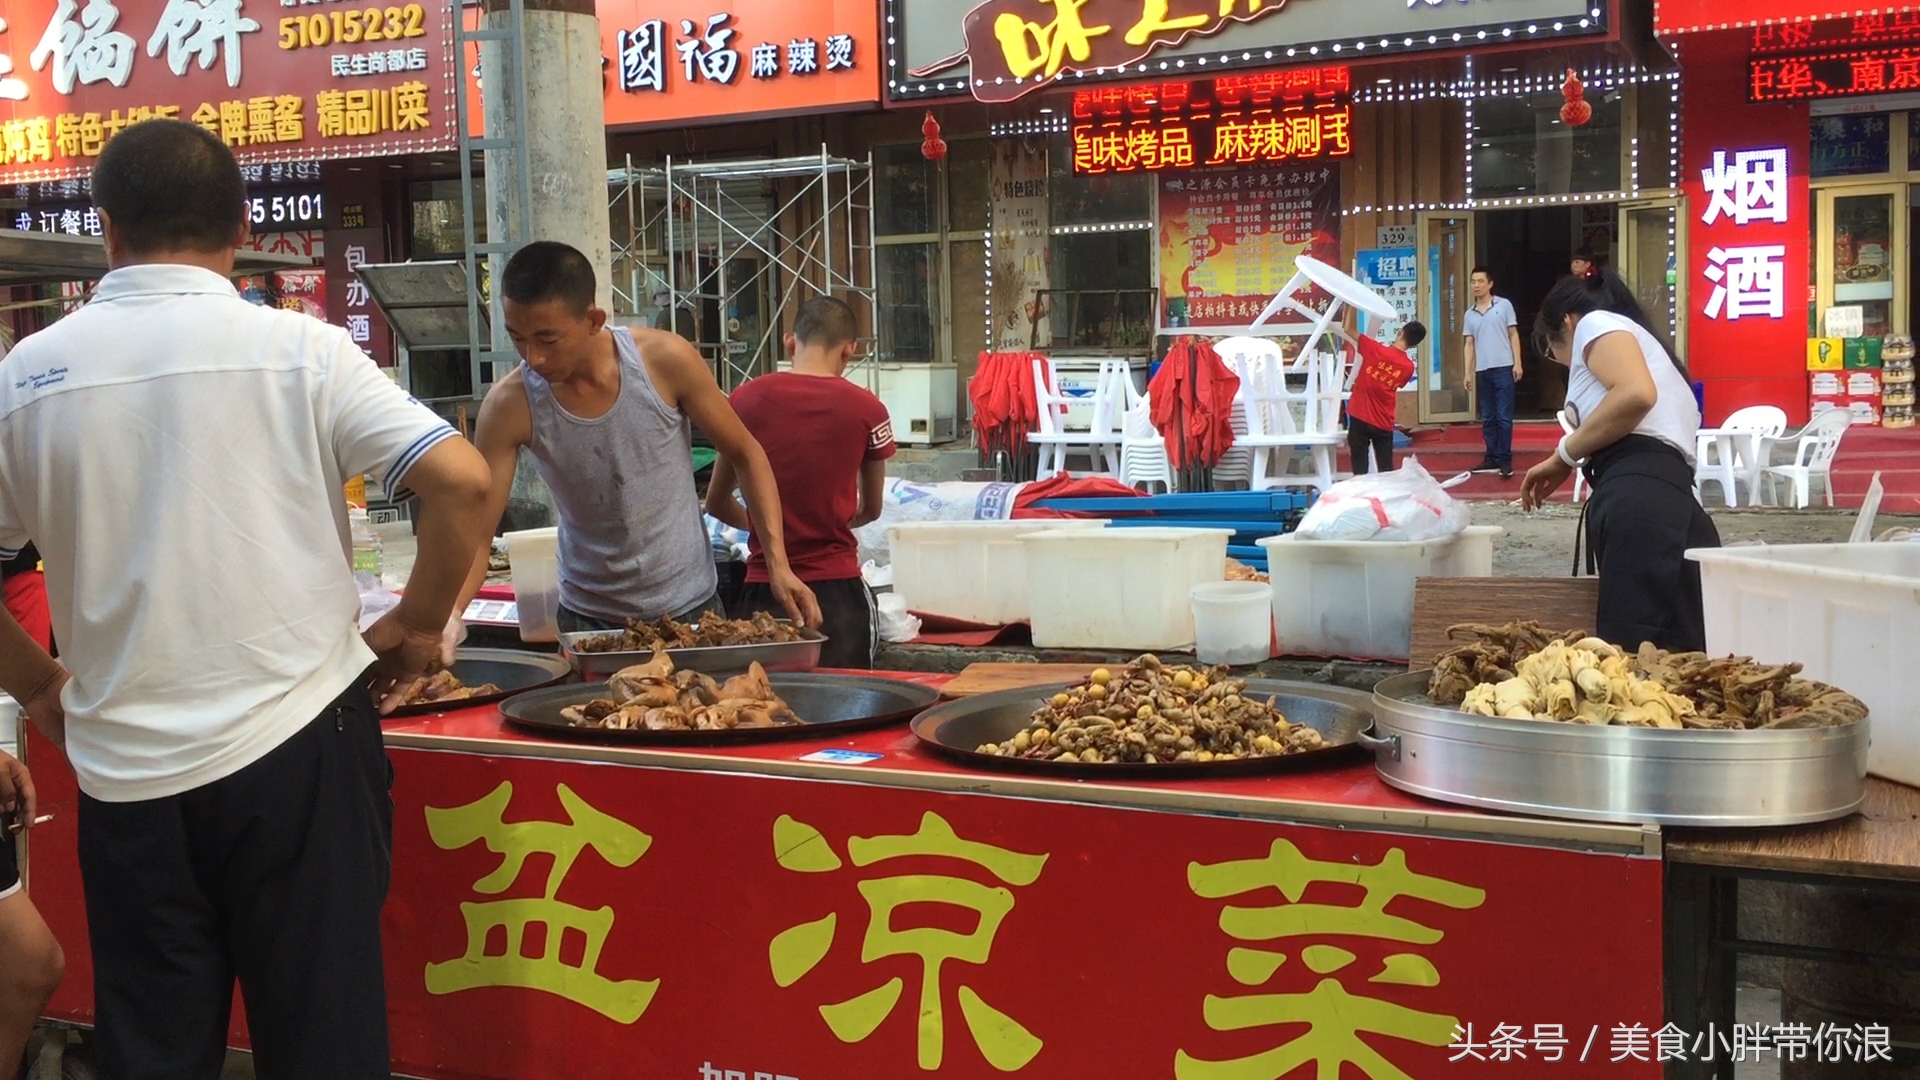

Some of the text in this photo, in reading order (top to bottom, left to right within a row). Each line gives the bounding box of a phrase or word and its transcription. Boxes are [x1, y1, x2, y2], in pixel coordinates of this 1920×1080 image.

[0, 0, 261, 100] 馅饼
[278, 4, 426, 49] 51015232
[331, 48, 428, 77] 民生尚都店
[600, 13, 854, 91] 國福 麻辣烫
[0, 114, 53, 164] 炖鸡
[192, 94, 304, 147] 金牌熏酱
[316, 80, 430, 137] 精品川菜
[272, 193, 323, 222] 5101
[1701, 148, 1788, 320] 烟酒
[344, 245, 373, 354] 包办酒
